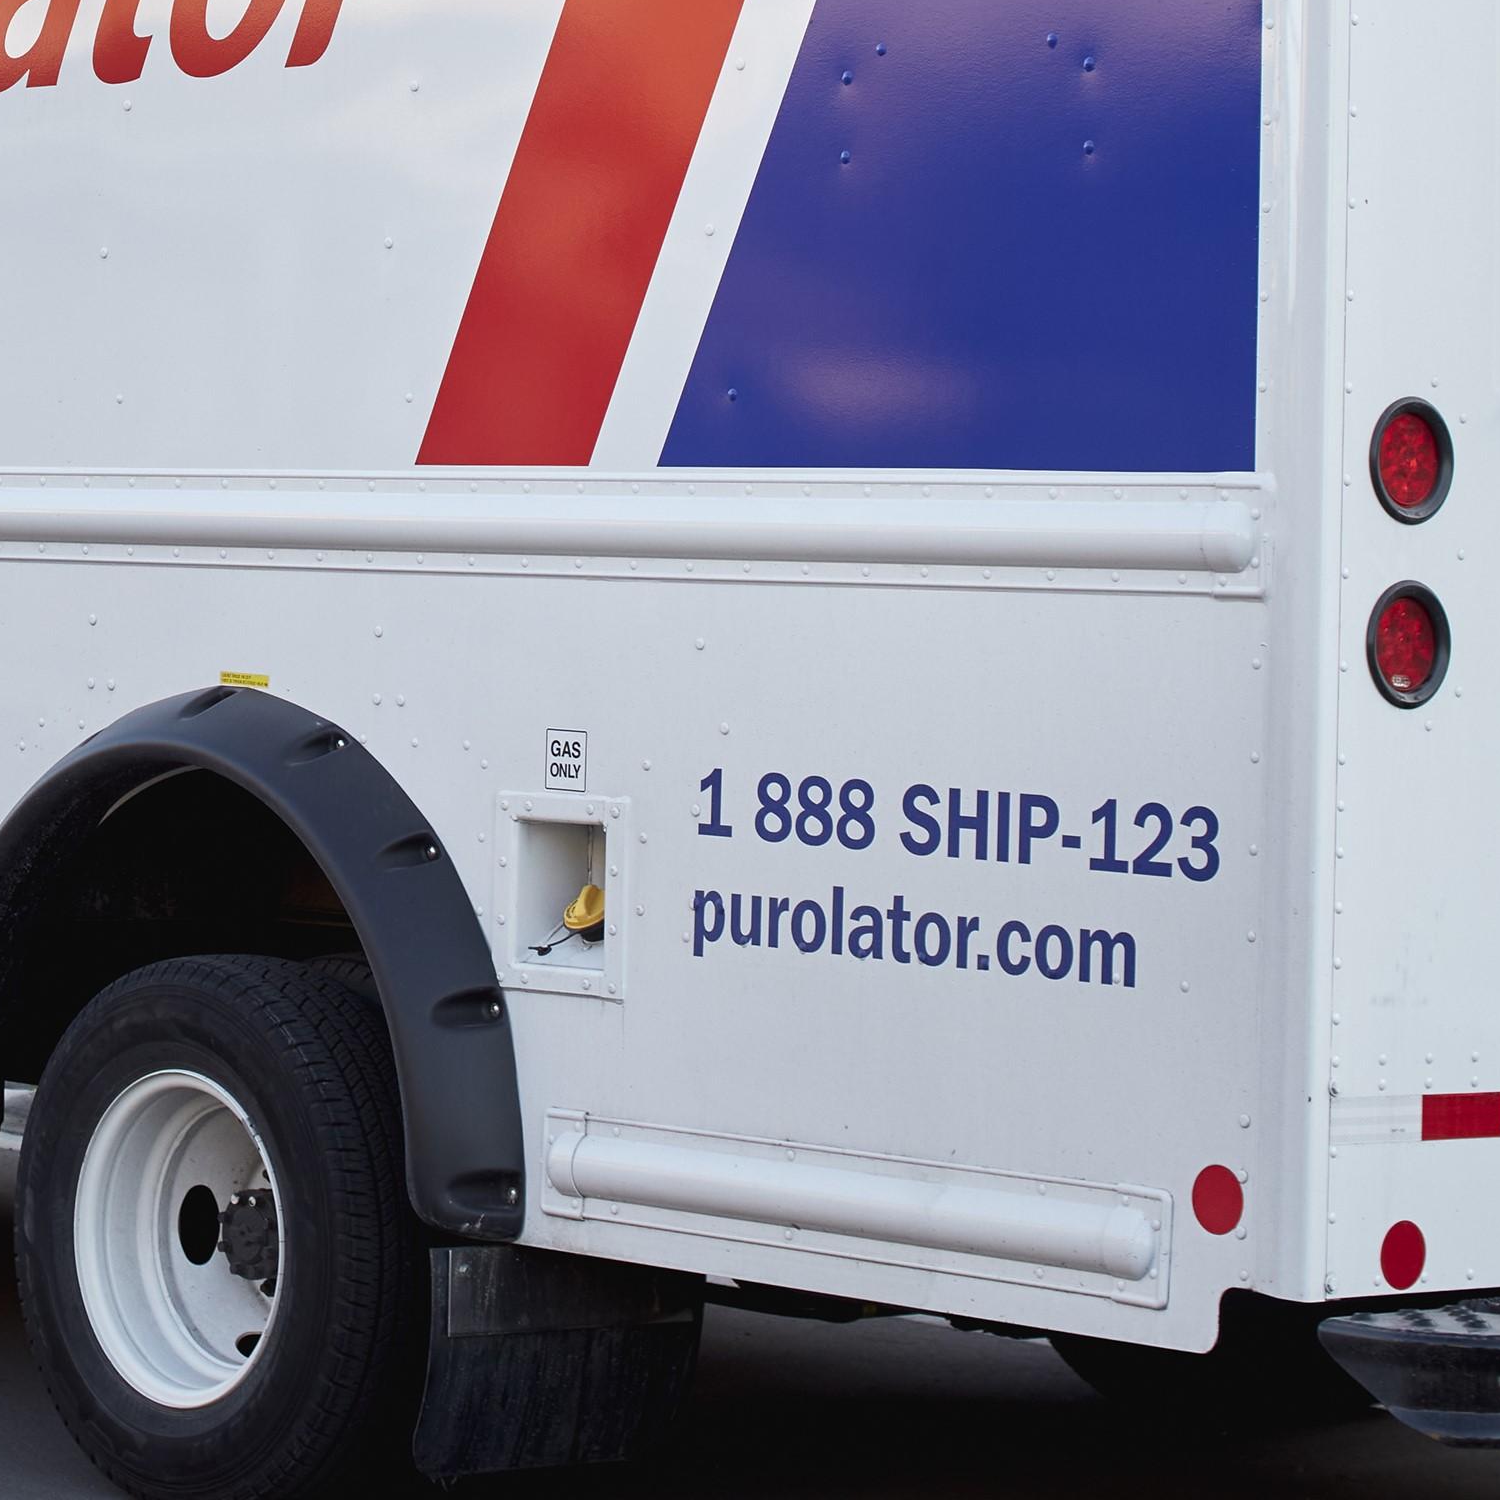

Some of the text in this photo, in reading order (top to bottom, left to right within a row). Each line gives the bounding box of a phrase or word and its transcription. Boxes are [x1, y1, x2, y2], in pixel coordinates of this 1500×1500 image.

[550, 762, 581, 779] ONLY
[551, 740, 581, 759] GAS
[698, 768, 1220, 881] 1 888 SHIP-123
[693, 886, 1136, 988] purolator.com
